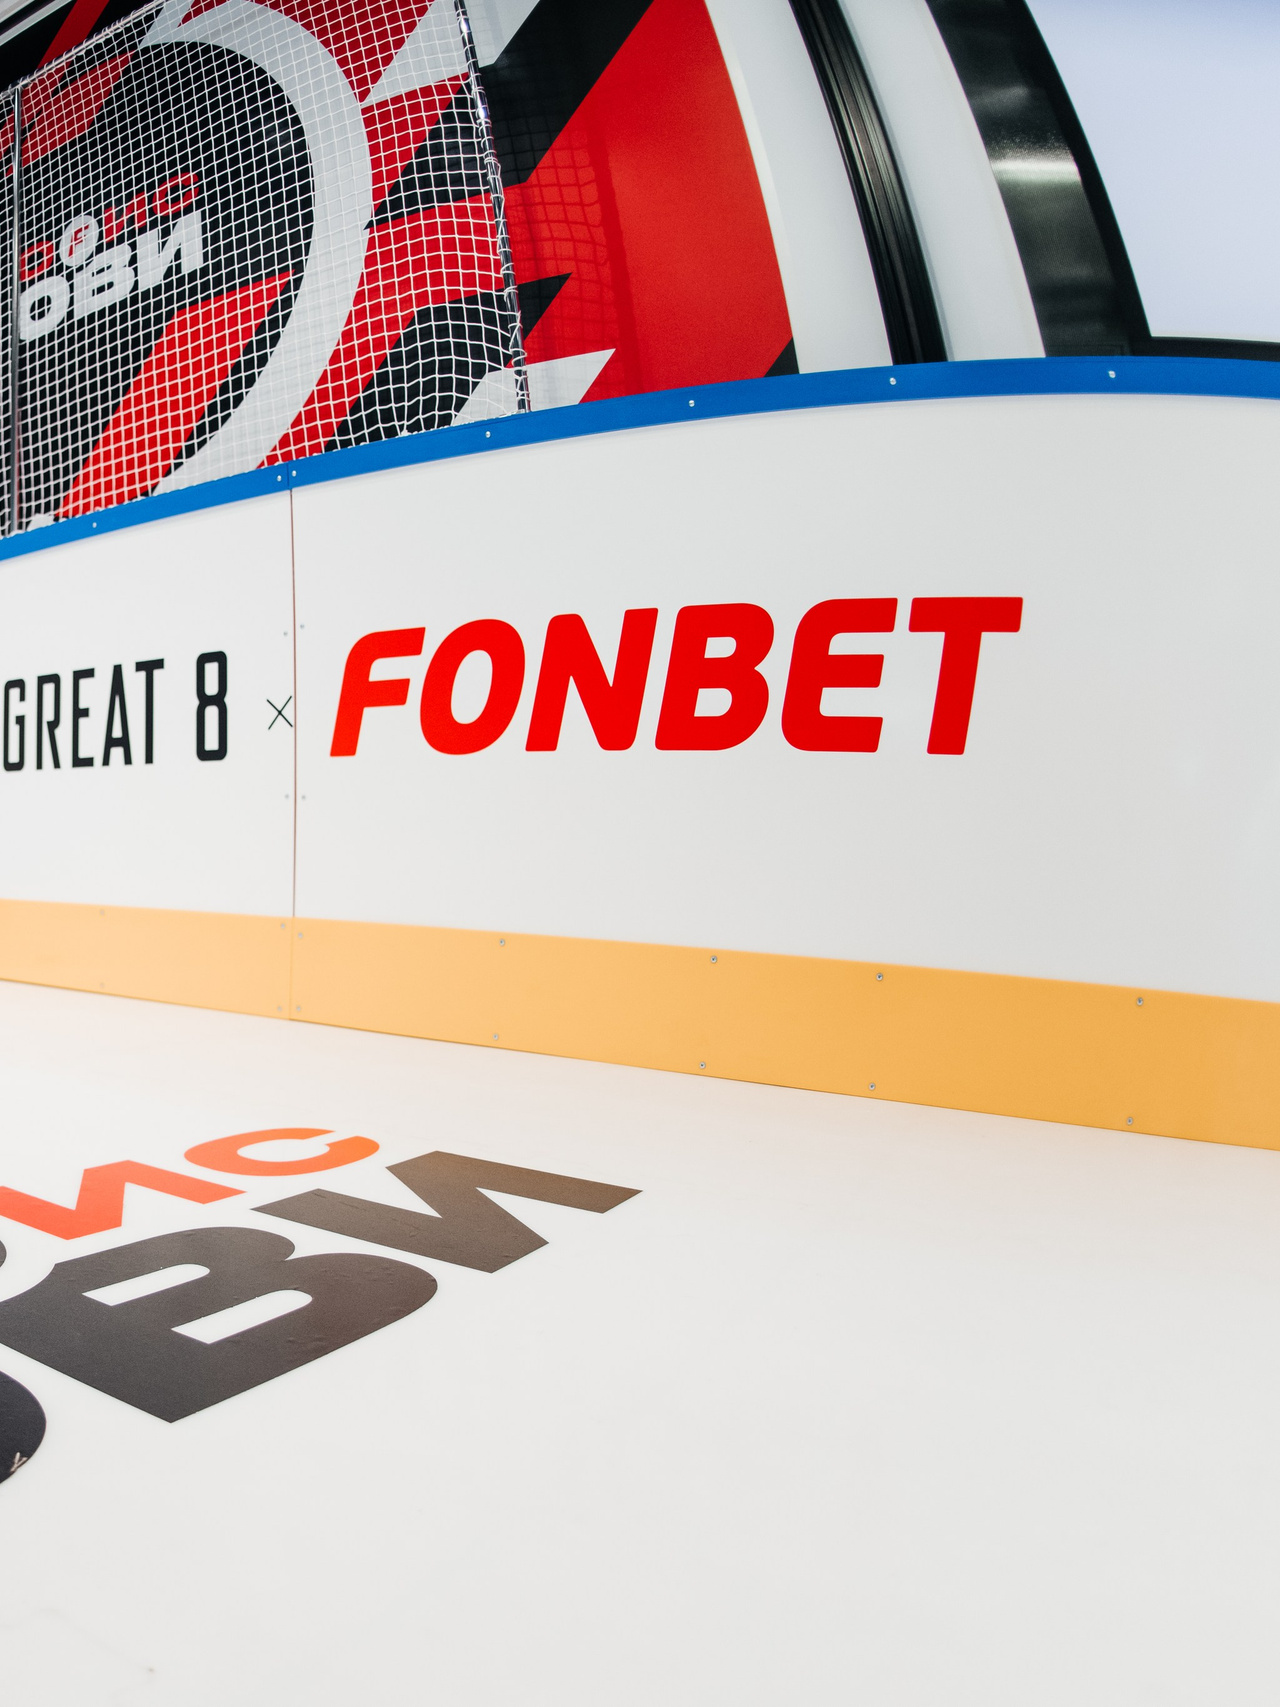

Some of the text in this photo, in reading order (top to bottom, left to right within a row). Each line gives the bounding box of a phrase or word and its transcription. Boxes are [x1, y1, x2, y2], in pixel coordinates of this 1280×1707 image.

[19, 211, 204, 341] ОВИ
[3, 658, 165, 772] GREAT
[195, 650, 228, 762] 8
[329, 596, 1024, 758] FONBET
